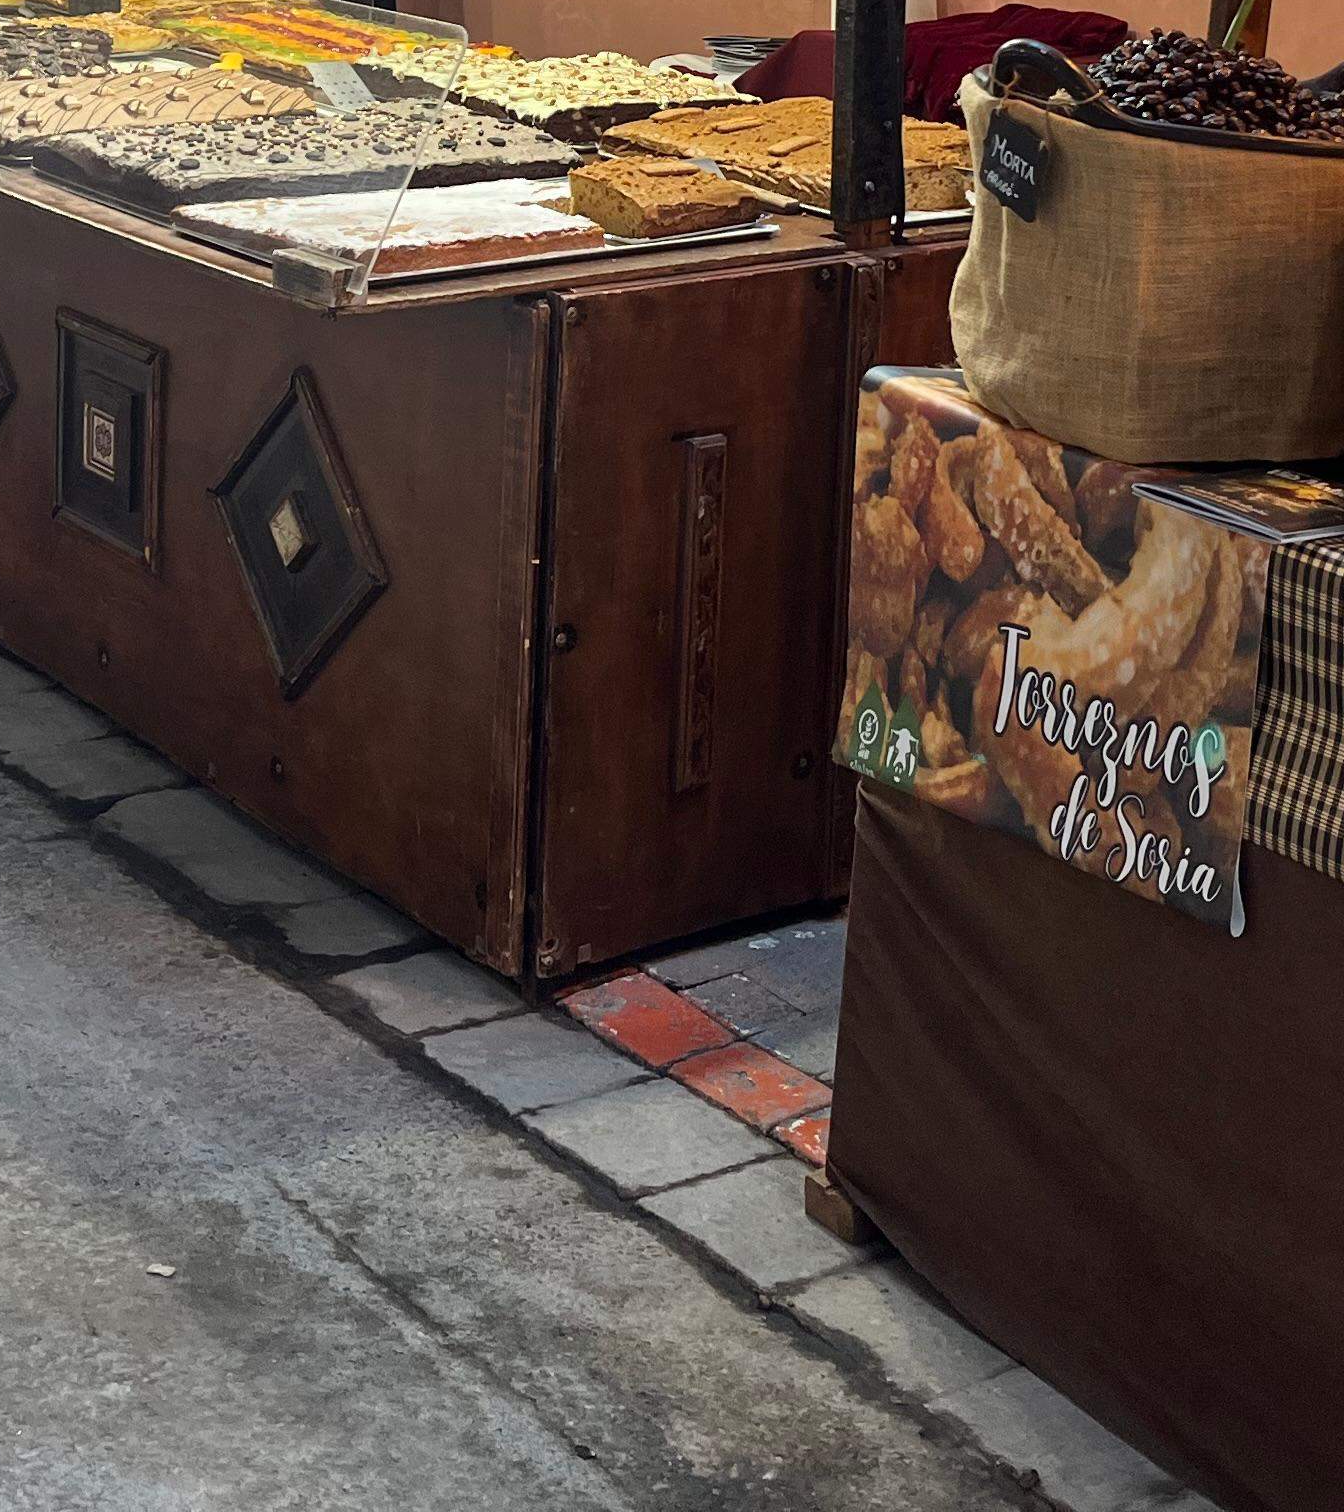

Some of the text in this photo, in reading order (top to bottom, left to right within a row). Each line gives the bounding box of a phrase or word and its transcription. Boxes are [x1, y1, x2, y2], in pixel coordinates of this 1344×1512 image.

[991, 133, 1036, 186] MORTA
[994, 624, 1225, 819] Torreznos
[1050, 774, 1223, 903] de Soria
